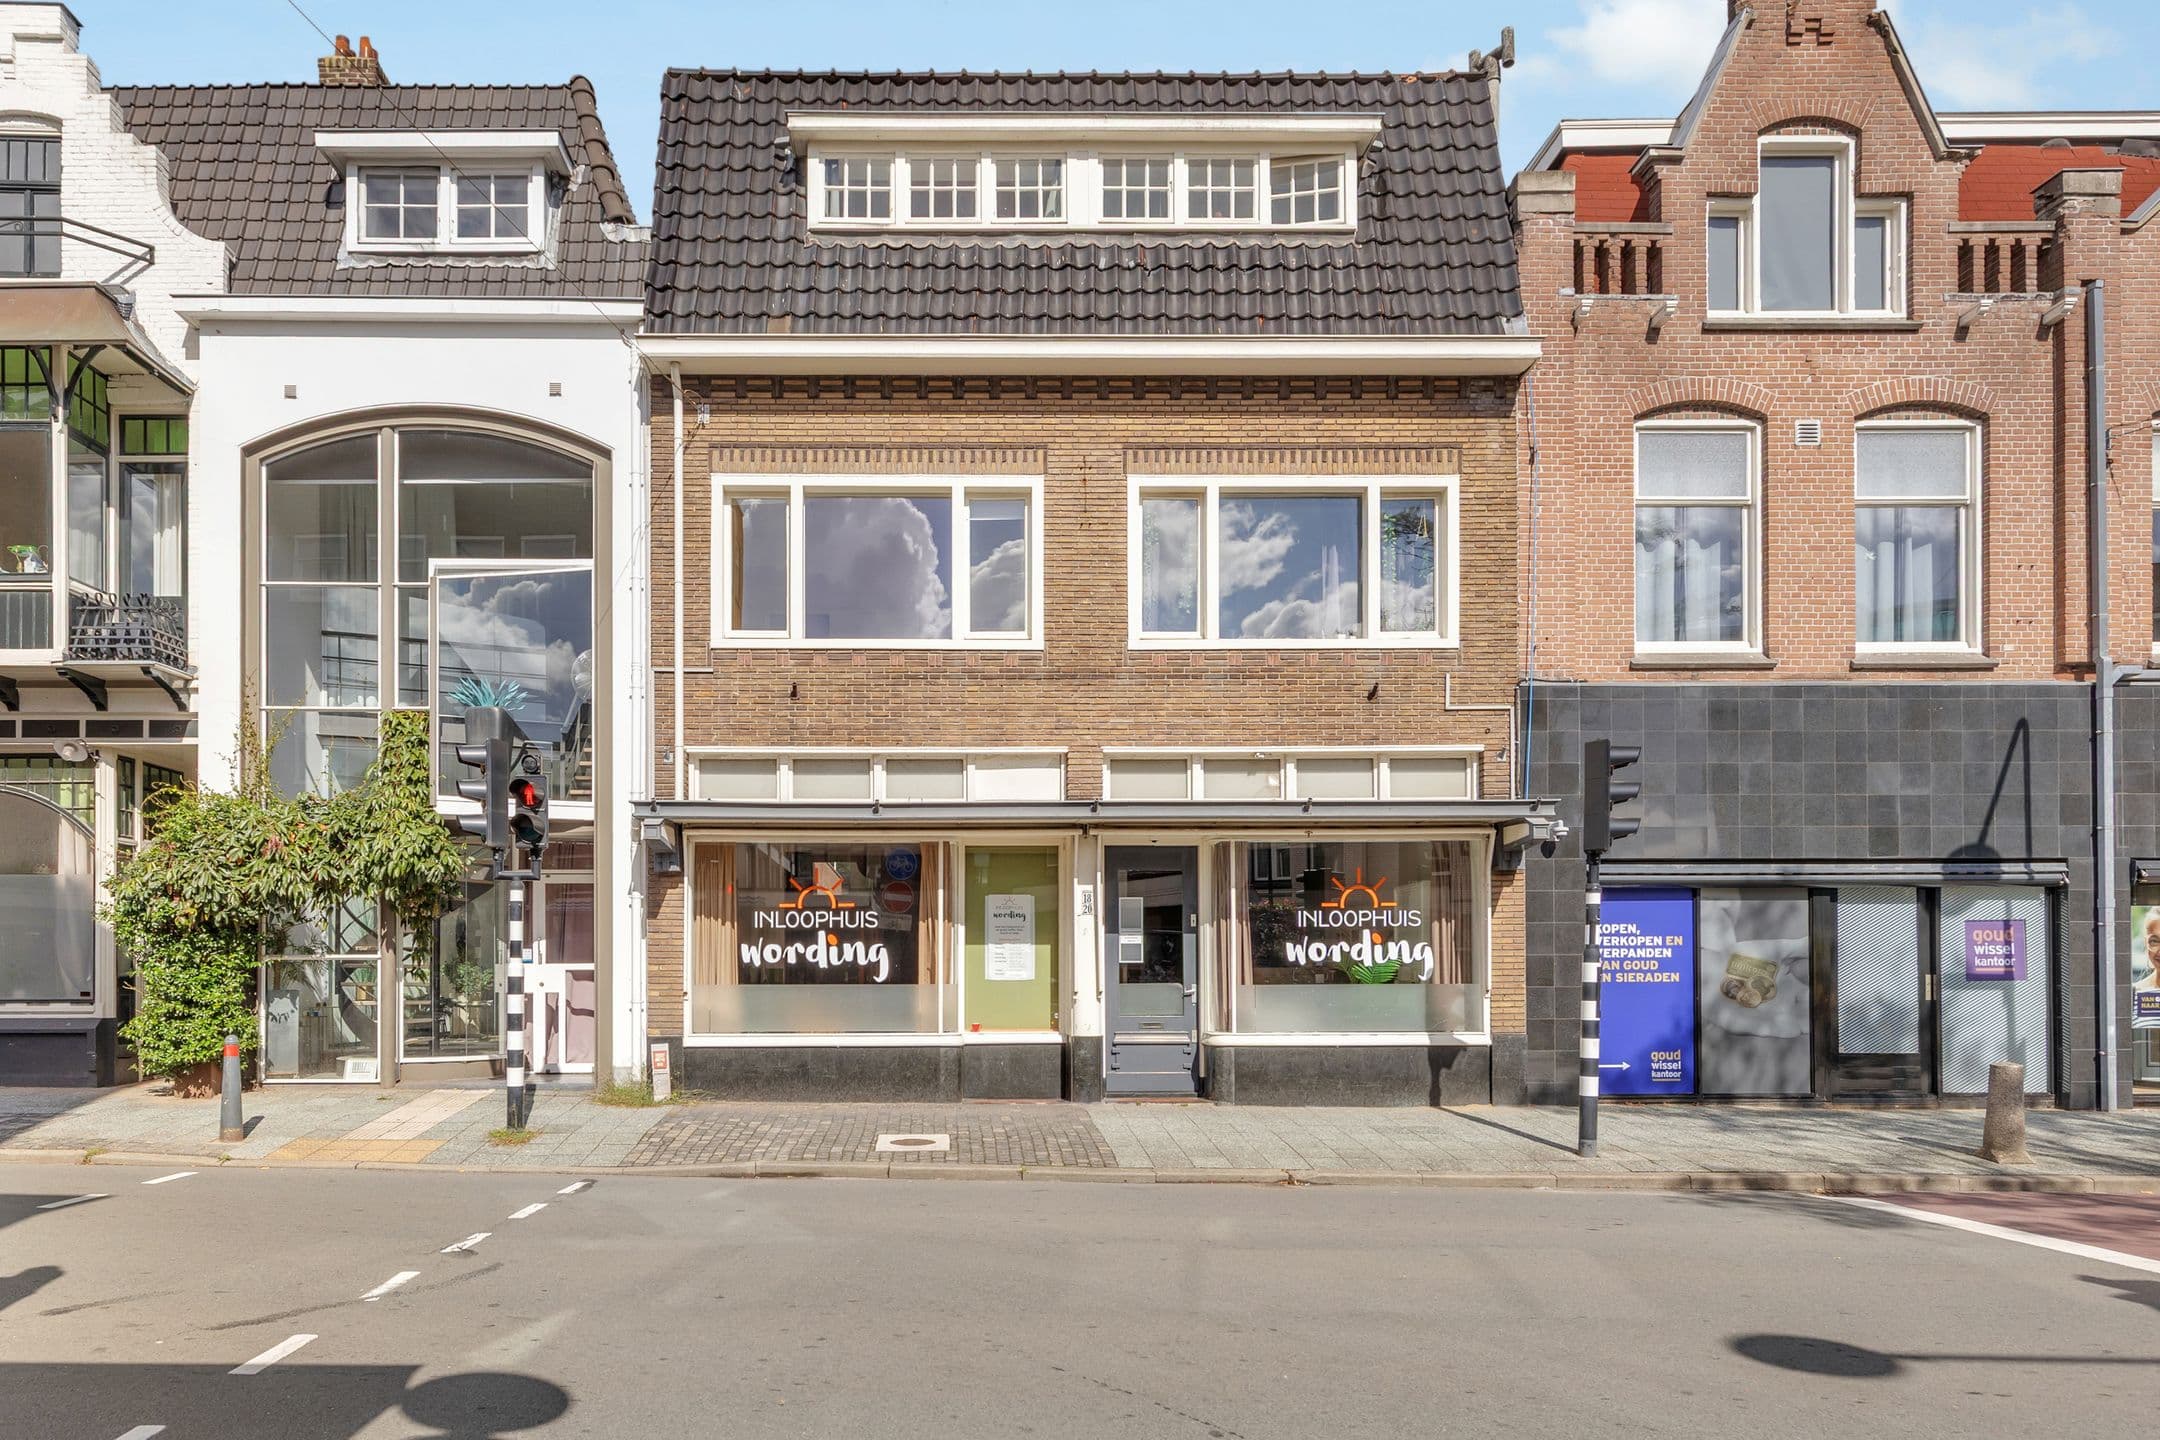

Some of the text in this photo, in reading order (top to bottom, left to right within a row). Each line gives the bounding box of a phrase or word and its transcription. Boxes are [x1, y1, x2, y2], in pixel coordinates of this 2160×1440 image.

[1083, 893, 1092, 903] 18
[1083, 904, 1092, 914] 20
[754, 911, 879, 929] INLOOPHUIS
[993, 910, 1026, 922] wording
[1297, 909, 1422, 928] INLOOPHUIS
[1665, 936, 1683, 946] EN
[1973, 927, 2015, 944] goud
[1974, 943, 2015, 955] wissel
[741, 930, 889, 983] wording
[1286, 929, 1434, 981] wording
[1601, 960, 1658, 970] AN GOUD
[1974, 957, 2016, 967] kantoor
[1616, 973, 1680, 983] SIERADEN
[1651, 1049, 1681, 1062] goud
[1651, 1061, 1681, 1070] wissel
[1652, 1070, 1681, 1078] kantoor
